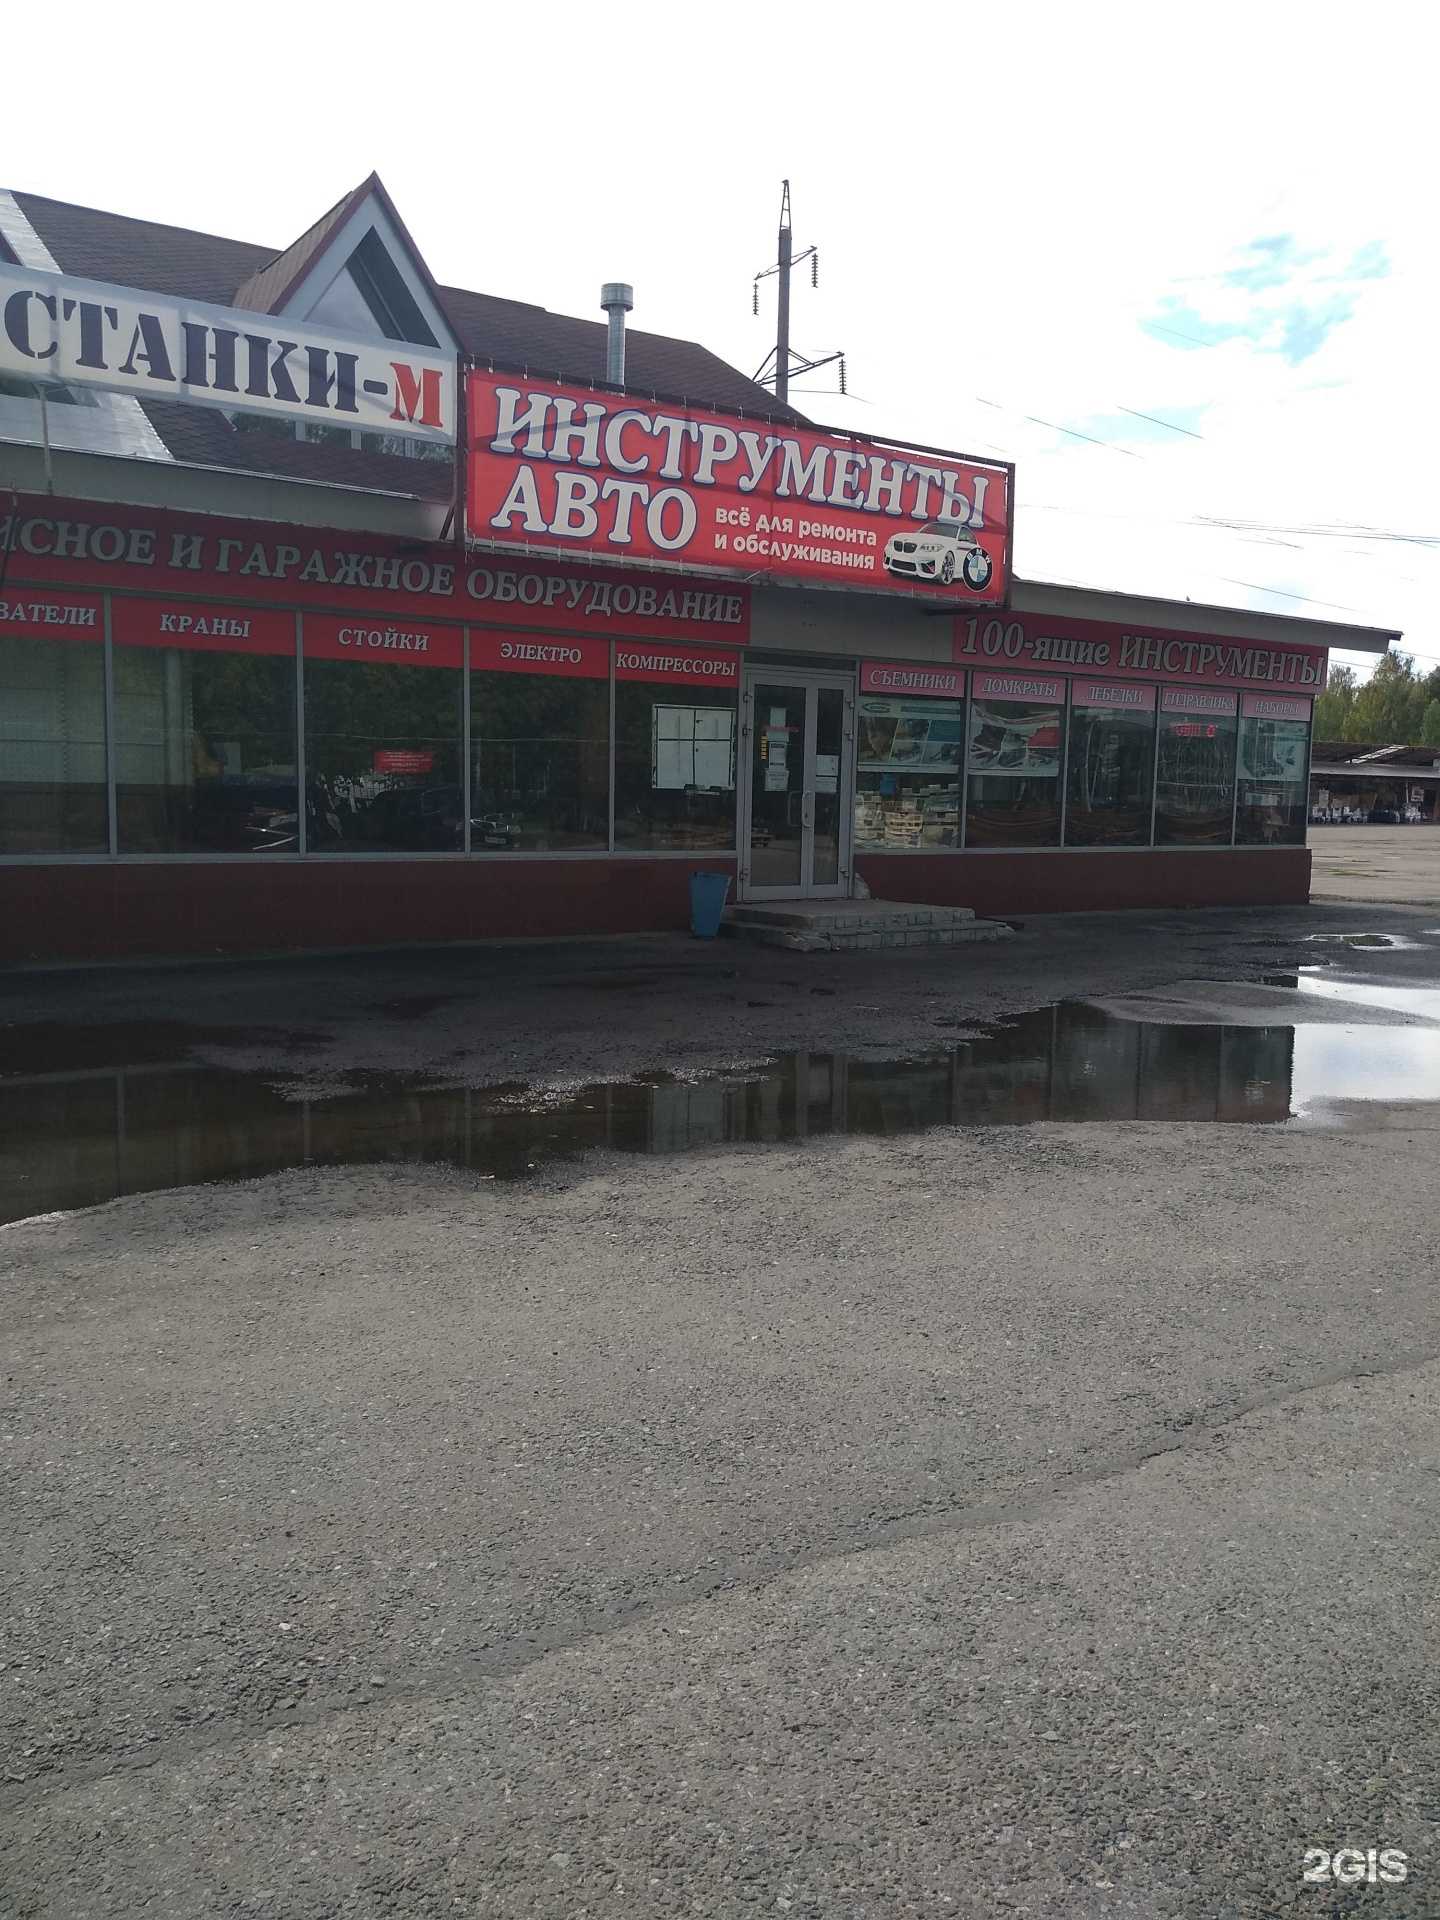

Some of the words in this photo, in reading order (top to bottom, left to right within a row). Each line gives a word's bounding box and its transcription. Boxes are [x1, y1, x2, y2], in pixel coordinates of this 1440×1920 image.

[4, 290, 443, 427] СТАНКИ-М
[490, 387, 989, 529] ИНСТРУМЕНТЫ
[491, 464, 698, 550] АВТО
[715, 507, 751, 527] всё
[756, 514, 793, 532] для
[799, 519, 877, 546] ремонта
[733, 535, 875, 570] обслуживания
[168, 534, 206, 569] И
[216, 539, 455, 596] ГАРАЖНОЕ
[467, 569, 743, 624] ОБОРУДОВАНИЕ
[160, 614, 250, 638] КРАНЫ
[338, 627, 429, 651] СТОЙКИ
[500, 642, 582, 664] ЭЛЕКТРО
[616, 653, 736, 676] КОМПРЕССОРЫ
[963, 617, 1110, 666] 100-ящие
[1118, 635, 1326, 686] ИНСТРУМЕНТЫ
[870, 670, 957, 690] СЪЕМНИКИ
[982, 678, 1058, 697] ДОМКРАТЫ
